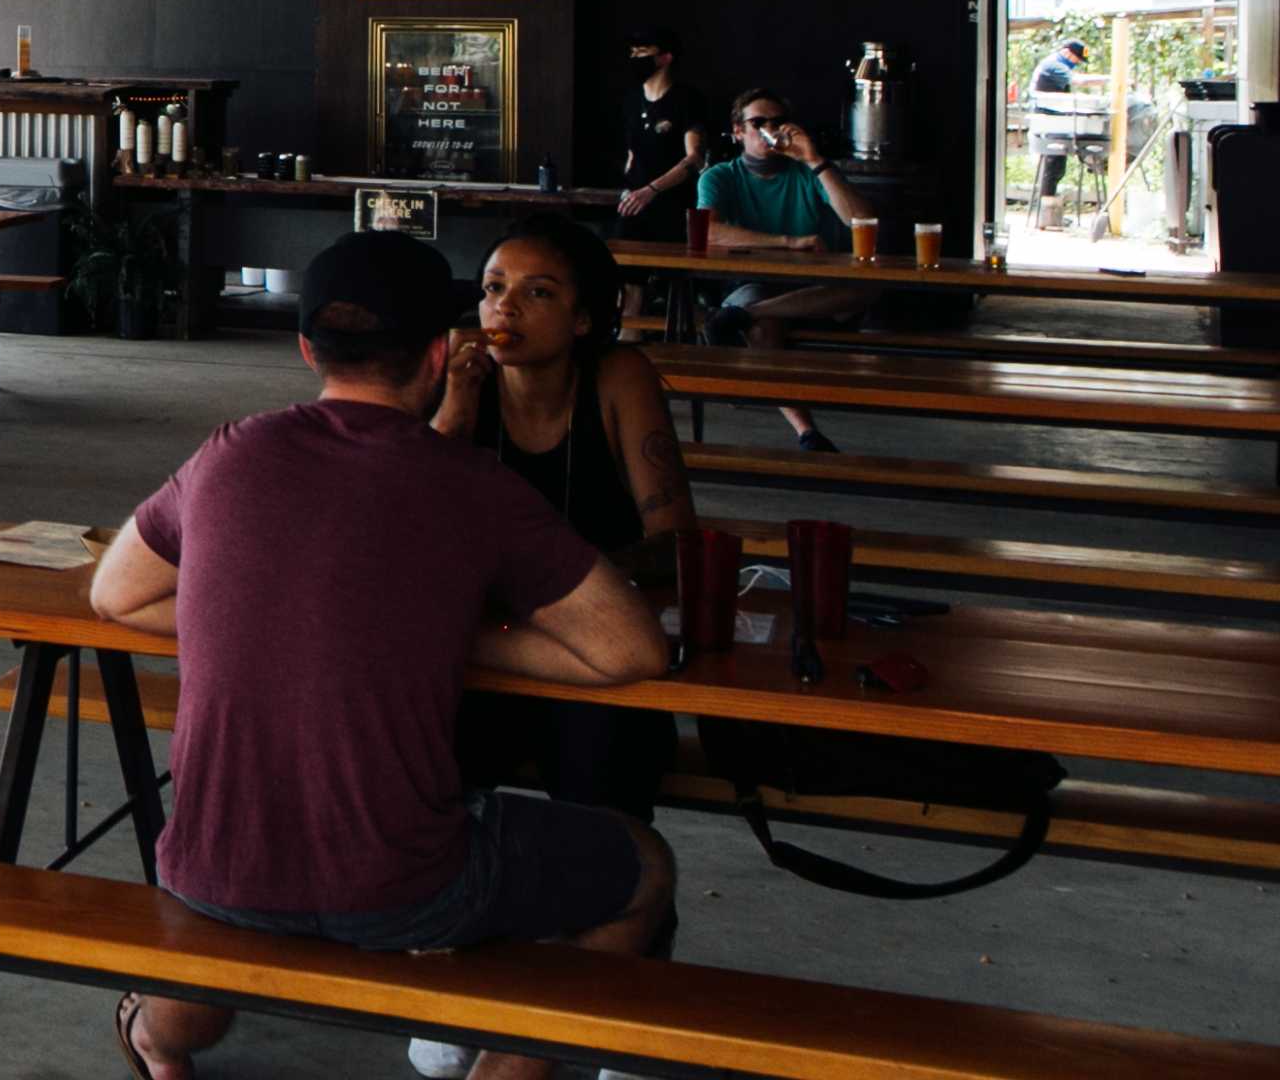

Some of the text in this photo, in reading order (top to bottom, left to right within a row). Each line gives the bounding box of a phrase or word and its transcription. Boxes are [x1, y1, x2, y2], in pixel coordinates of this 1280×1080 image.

[418, 66, 465, 76] BEER
[424, 84, 459, 93] FOR
[423, 101, 461, 111] NOT
[418, 119, 465, 129] HERE
[367, 197, 424, 210] CHECK IN
